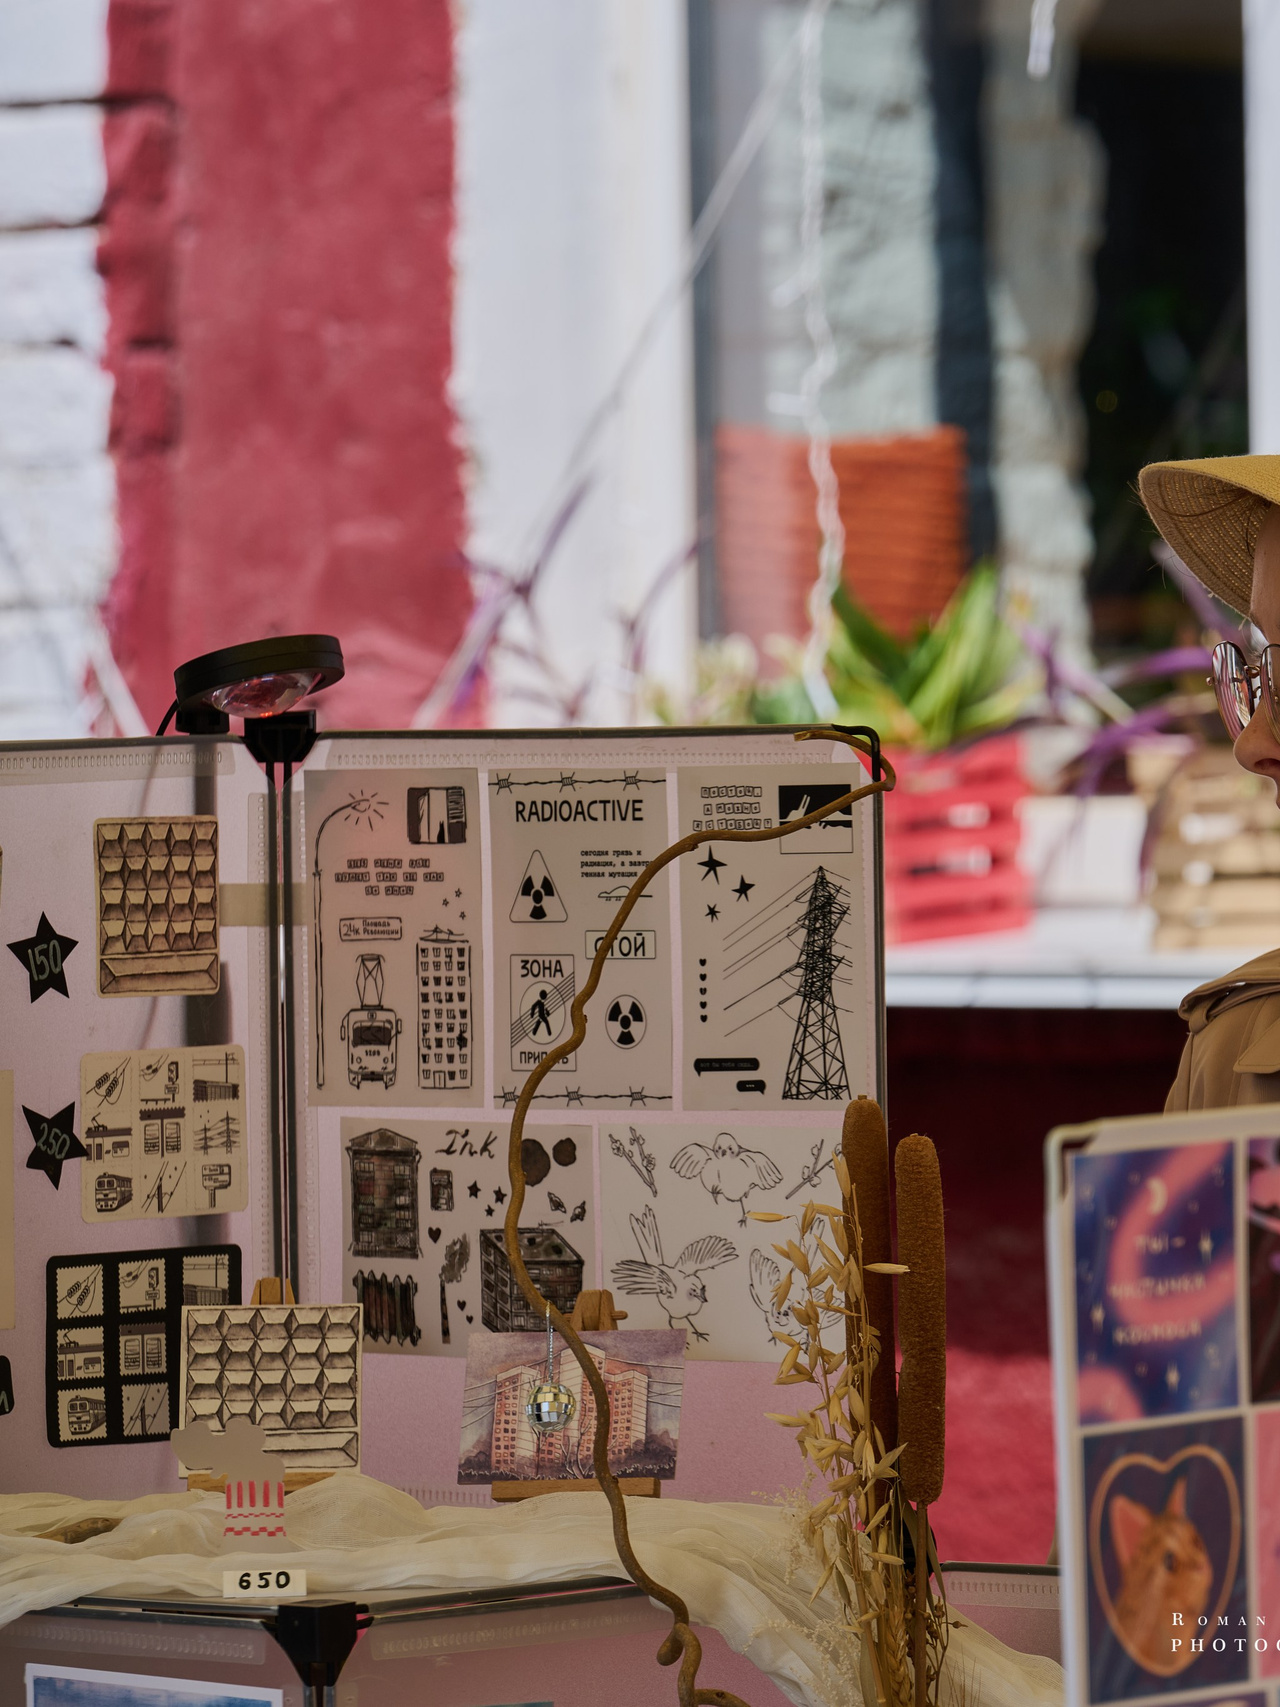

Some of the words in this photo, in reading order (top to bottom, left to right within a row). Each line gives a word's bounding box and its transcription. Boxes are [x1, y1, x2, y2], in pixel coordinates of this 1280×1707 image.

[515, 799, 644, 822] RADIOACTIVE
[612, 850, 633, 858] грязь
[580, 860, 616, 869] радиация,
[628, 860, 652, 869] завтр
[608, 871, 638, 879] мутация
[28, 939, 62, 981] 150
[520, 959, 564, 978] ЗОНА
[37, 1122, 70, 1159] 250
[435, 1128, 498, 1159] Ink
[239, 1571, 290, 1590] 650
